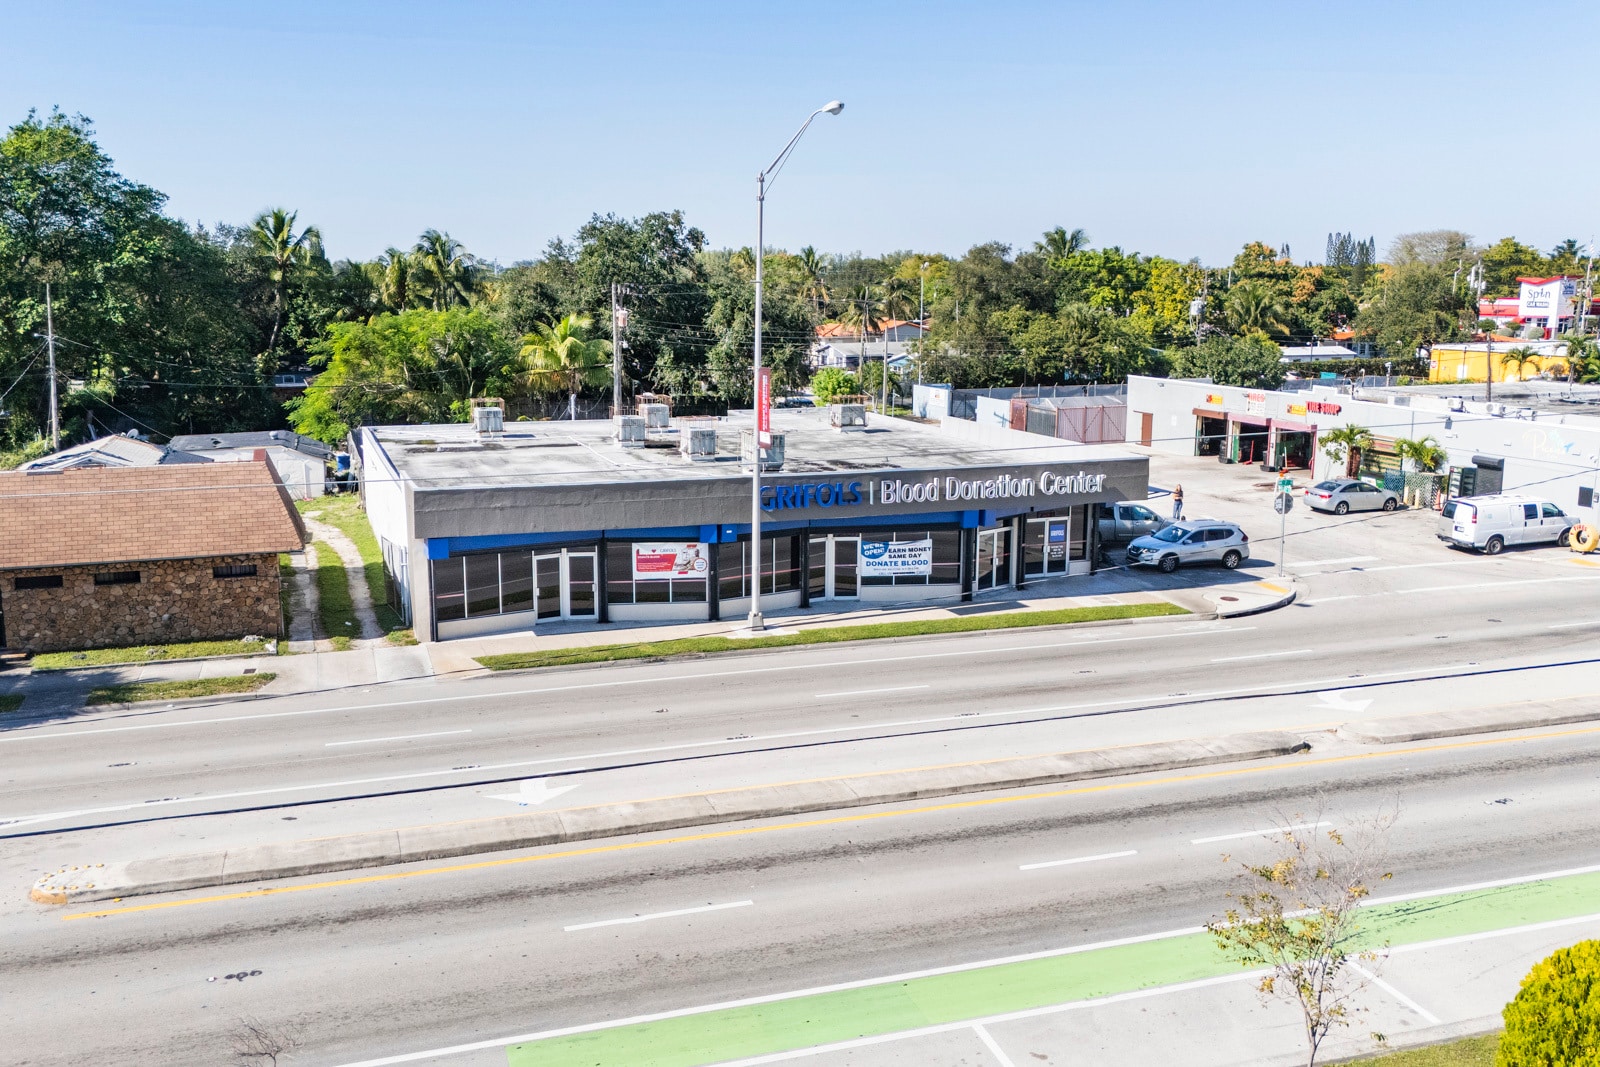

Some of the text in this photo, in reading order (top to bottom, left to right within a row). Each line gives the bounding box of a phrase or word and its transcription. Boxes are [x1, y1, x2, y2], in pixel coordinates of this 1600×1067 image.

[1306, 401, 1341, 415] TIRE SHOP
[760, 471, 1106, 512] GRIFOLS Blood Donation Center
